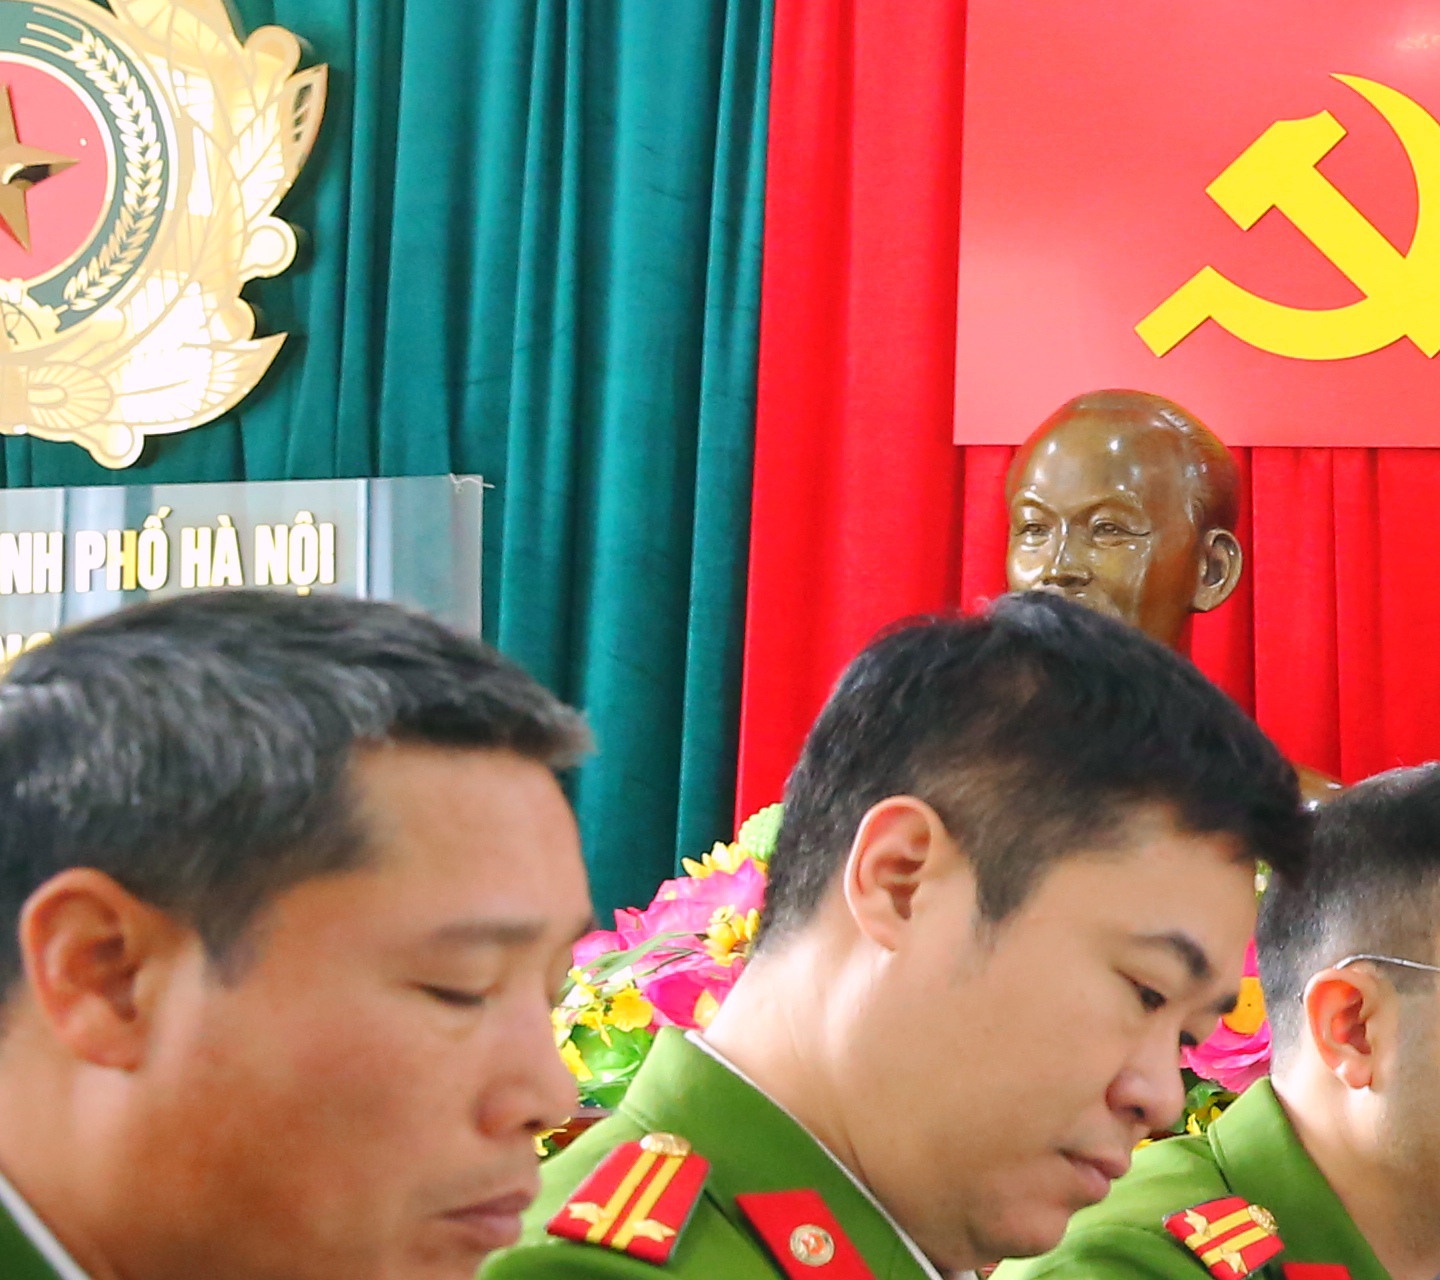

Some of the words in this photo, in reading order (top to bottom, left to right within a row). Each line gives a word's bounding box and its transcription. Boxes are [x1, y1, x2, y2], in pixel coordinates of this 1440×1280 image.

[75, 506, 172, 593] PHỐ
[181, 515, 244, 587] HÀ
[254, 510, 336, 596] NỘI
